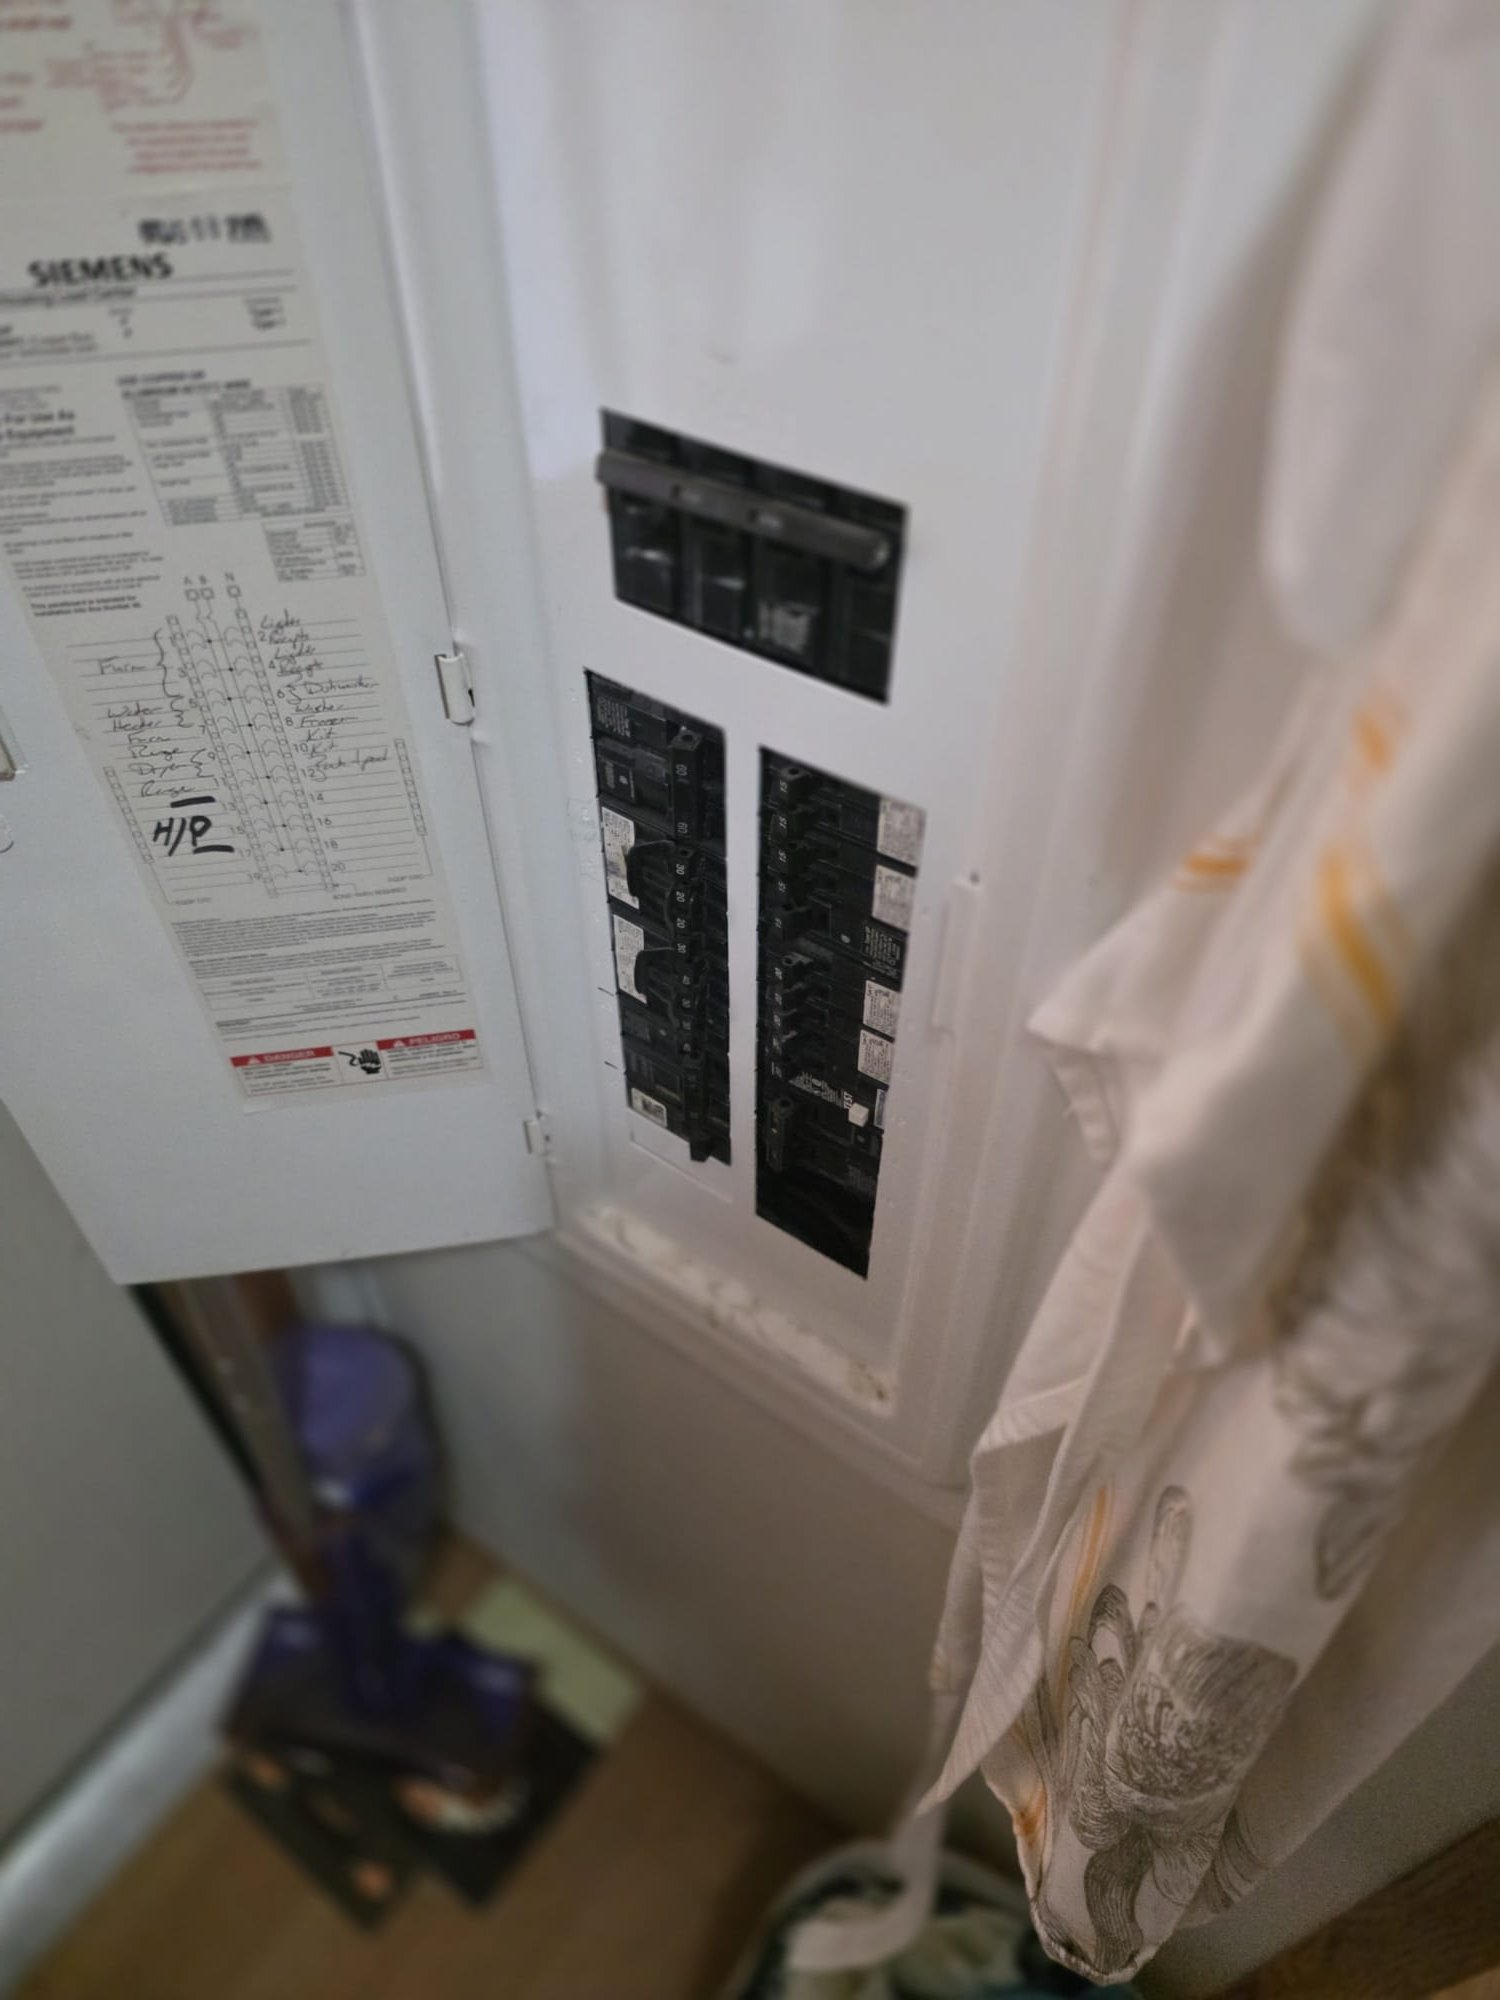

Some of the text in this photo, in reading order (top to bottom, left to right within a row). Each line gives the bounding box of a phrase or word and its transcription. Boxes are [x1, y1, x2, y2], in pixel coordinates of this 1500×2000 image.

[27, 252, 173, 287] SIEMENS
[257, 630, 266, 642] 2
[285, 716, 294, 727] 8
[293, 742, 308, 753] 10
[300, 768, 315, 778] 12
[309, 793, 324, 802] 14
[153, 815, 213, 857] H/P
[331, 862, 346, 872] 20
